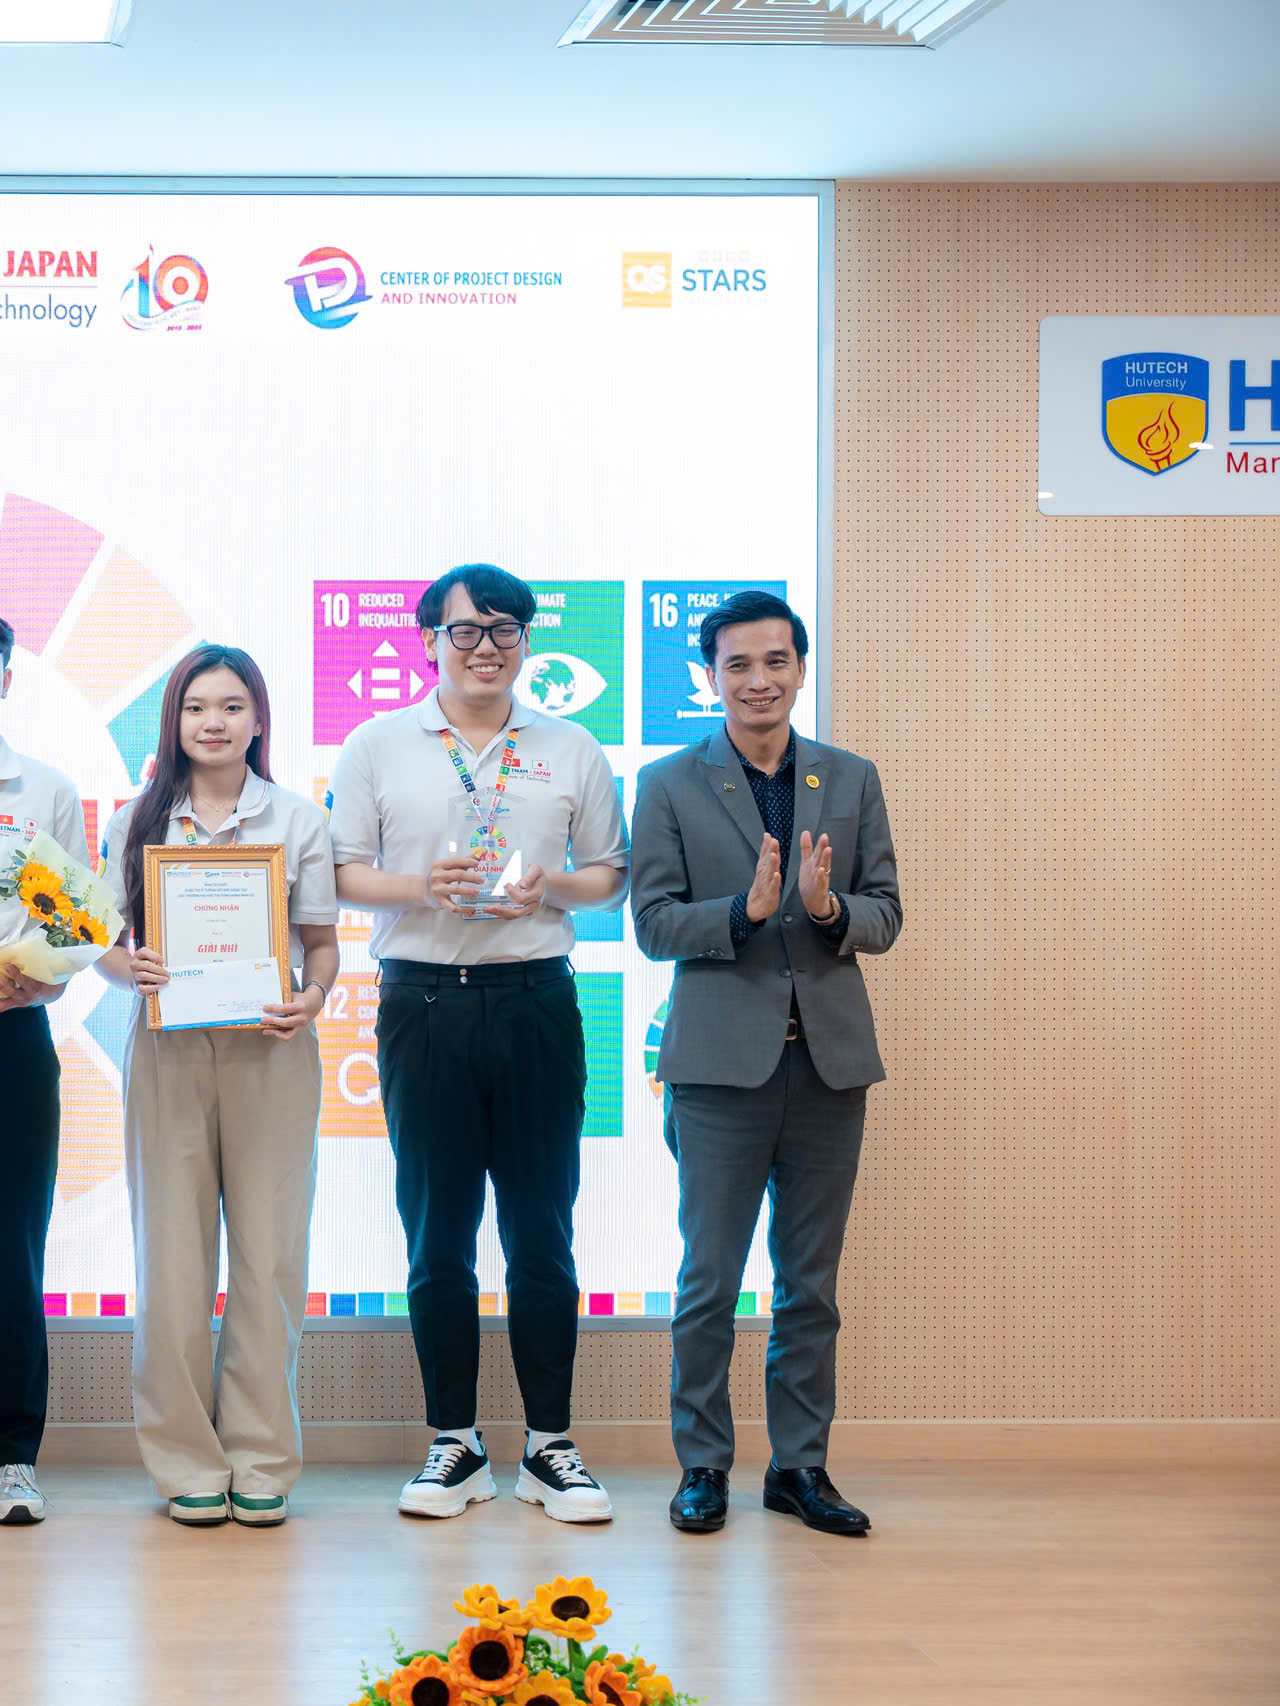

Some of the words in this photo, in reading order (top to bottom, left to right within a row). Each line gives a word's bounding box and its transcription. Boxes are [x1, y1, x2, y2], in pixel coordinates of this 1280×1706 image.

[3, 250, 98, 277] JAPAN
[380, 272, 430, 285] CENTER
[434, 272, 450, 285] OF
[454, 272, 509, 286] PROJECT
[513, 272, 562, 286] DESIGN
[682, 269, 767, 291] STARS
[381, 292, 413, 304] AND
[419, 292, 517, 304] INNOVATION
[1125, 361, 1188, 374] HUTECH
[1126, 376, 1187, 391] University
[536, 593, 566, 608] IMATE
[320, 592, 350, 628] 10
[358, 593, 405, 607] REDUCED
[649, 592, 679, 628] 16
[358, 613, 418, 628] INEQUALITIE
[530, 613, 561, 628] CTION
[172, 969, 204, 978] HUTECH
